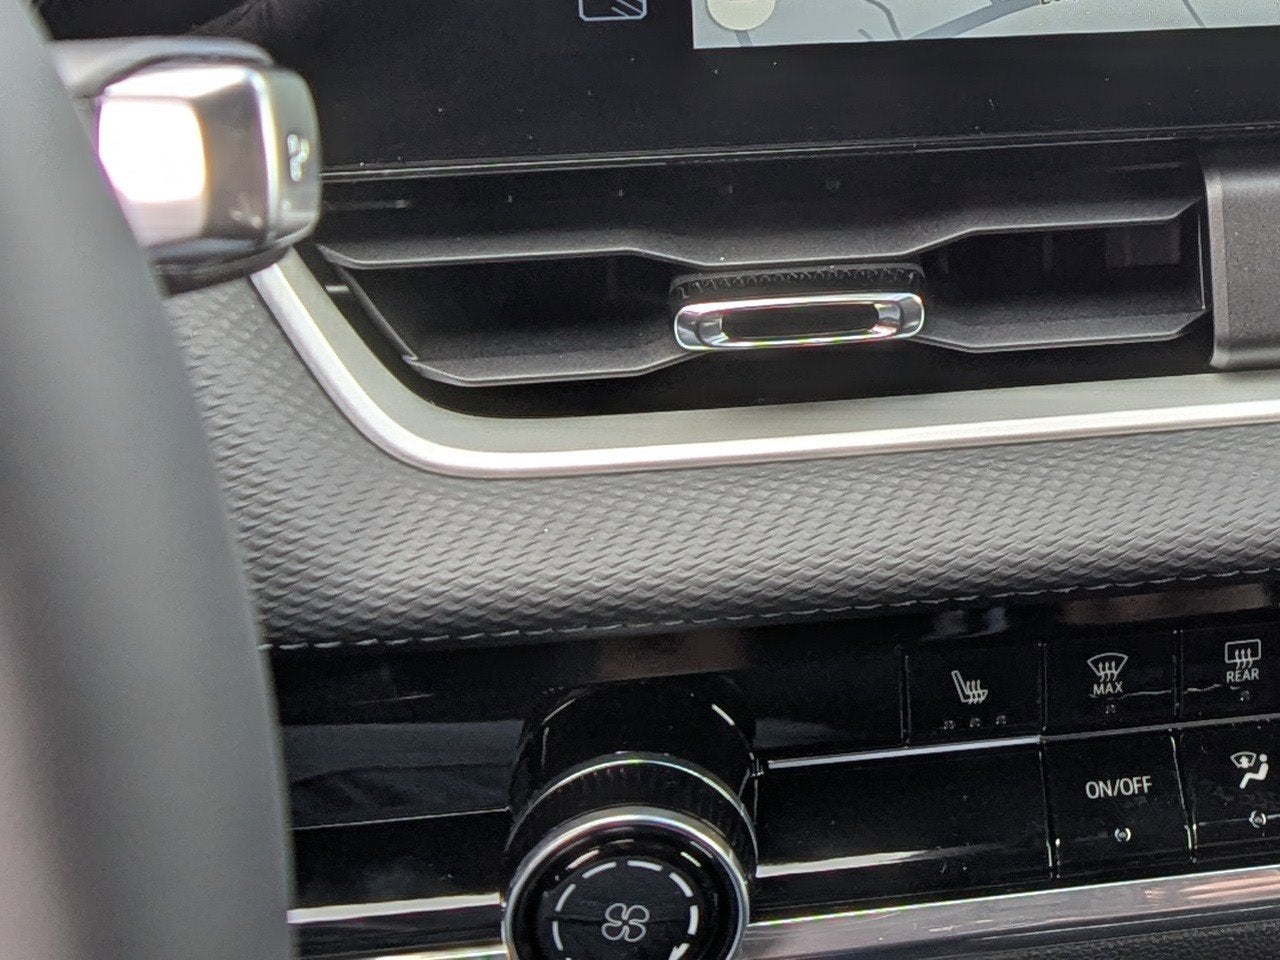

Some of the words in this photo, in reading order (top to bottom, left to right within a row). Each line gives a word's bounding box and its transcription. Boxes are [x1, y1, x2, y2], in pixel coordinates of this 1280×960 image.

[1226, 668, 1259, 684] REAR
[1093, 681, 1123, 696] MAX
[1085, 775, 1152, 800] ON/OFF
